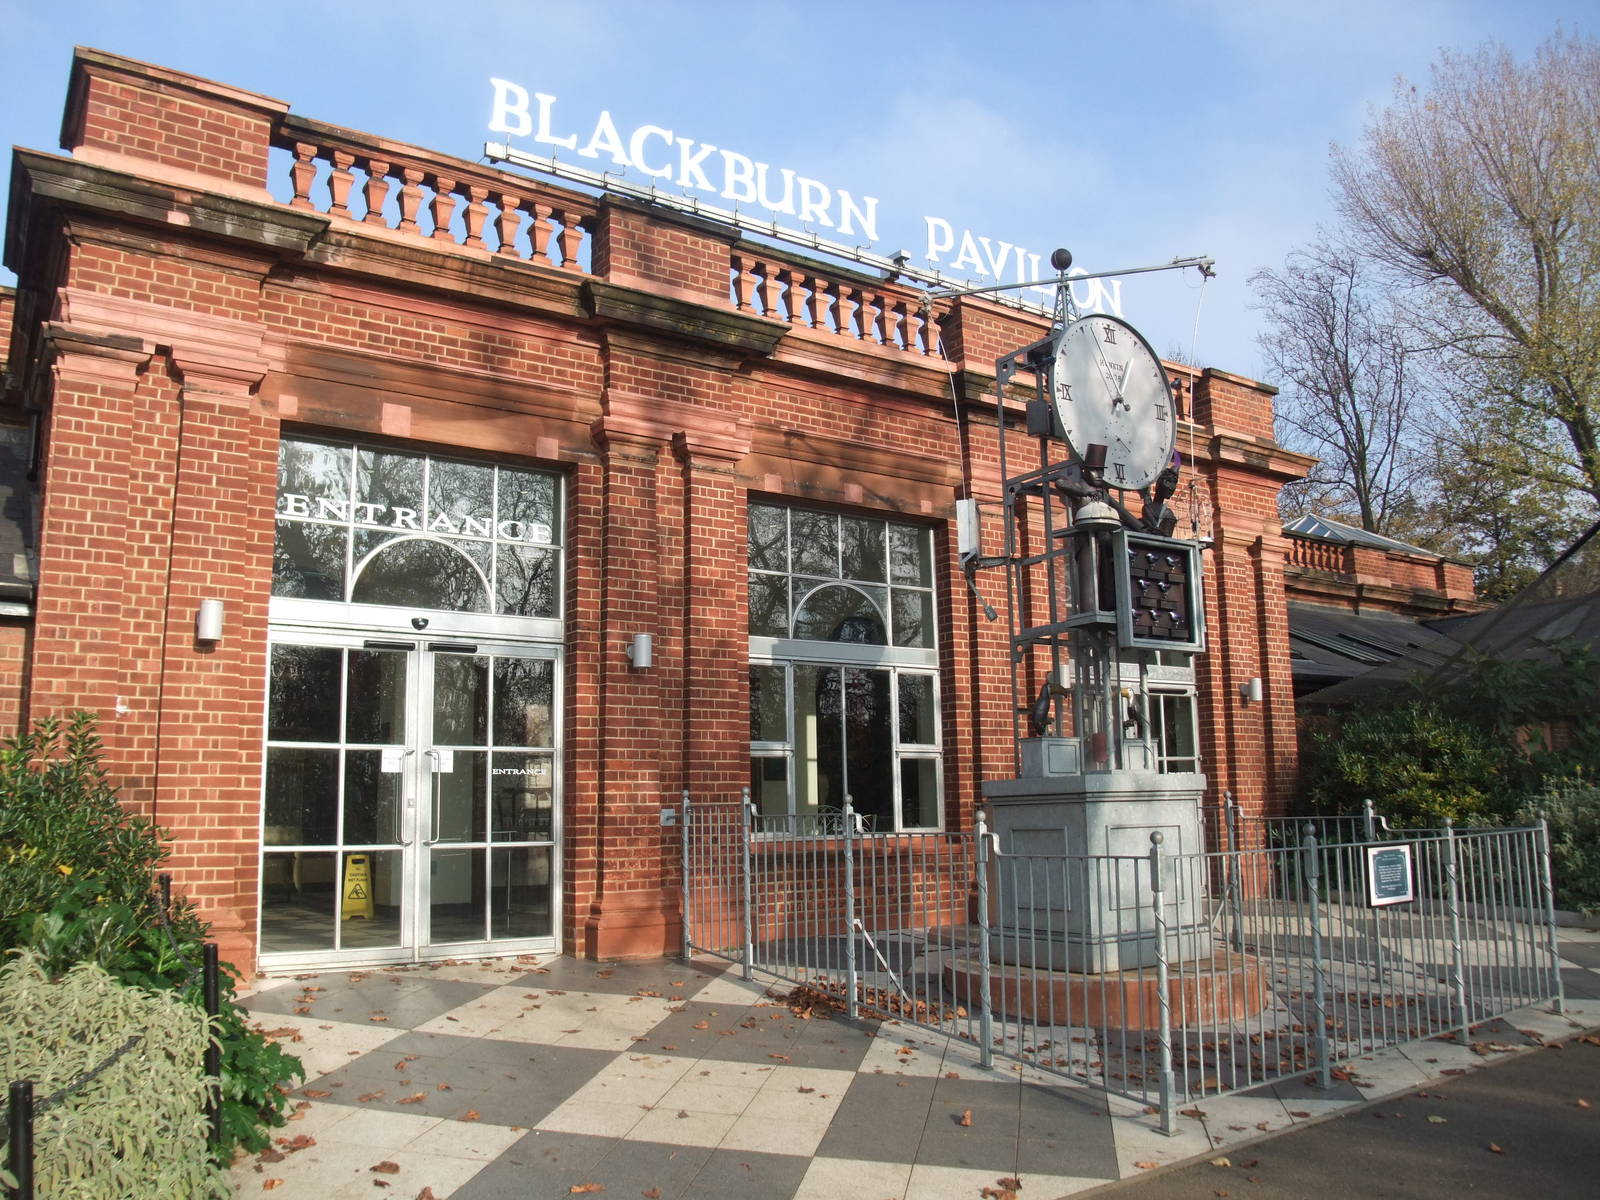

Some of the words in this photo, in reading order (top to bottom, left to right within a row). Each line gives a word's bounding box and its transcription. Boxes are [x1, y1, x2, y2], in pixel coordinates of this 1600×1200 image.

[489, 77, 879, 241] BLACKBURN
[923, 216, 1124, 318] PAVILON
[1103, 326, 1118, 345] XII
[1060, 383, 1073, 401] IX
[1153, 404, 1167, 422] III
[282, 493, 552, 543] ENTRANCE
[492, 768, 547, 776] ENTRANCE
